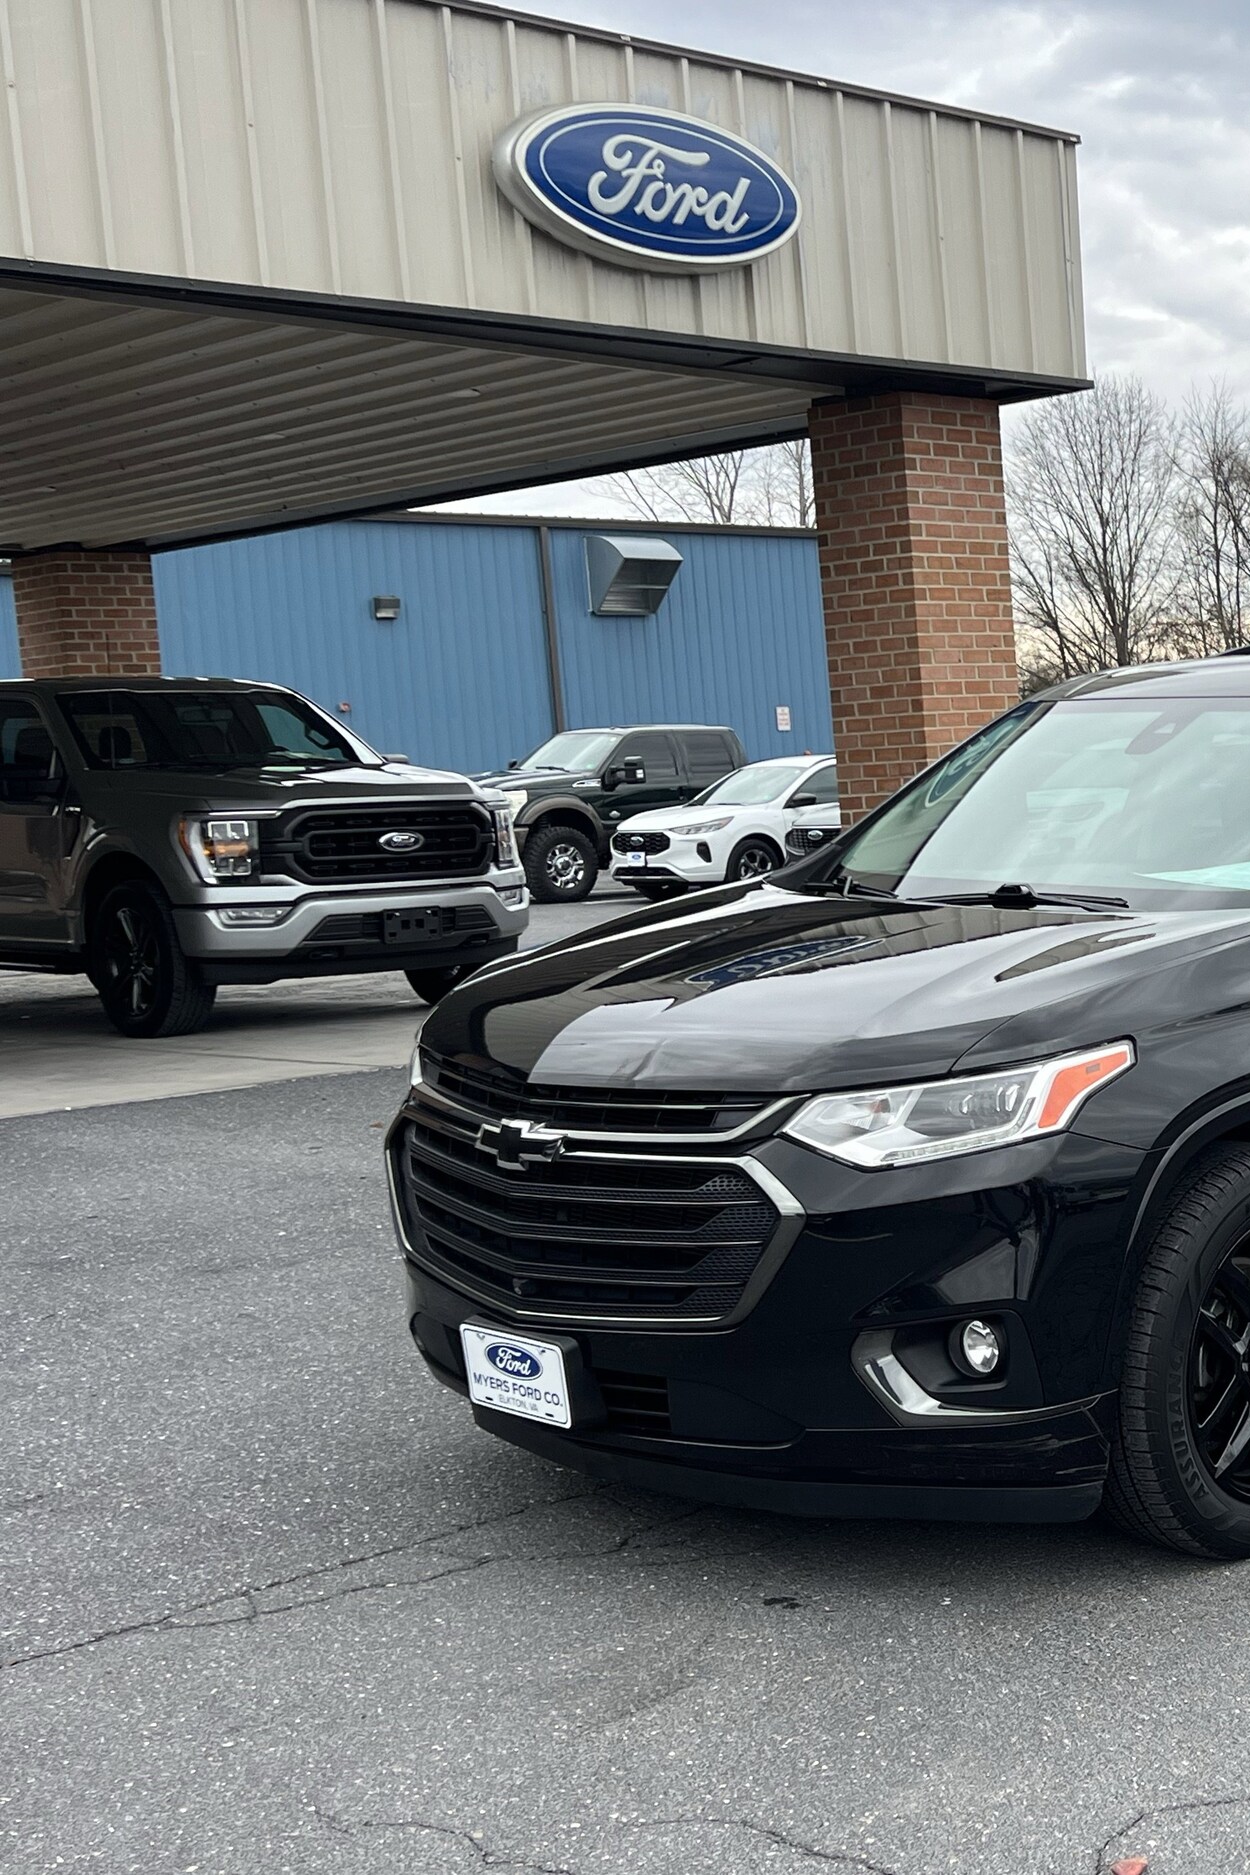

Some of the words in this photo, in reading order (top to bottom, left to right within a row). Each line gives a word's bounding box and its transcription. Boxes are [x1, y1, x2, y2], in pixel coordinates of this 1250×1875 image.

[587, 134, 751, 234] Ford
[496, 1346, 532, 1376] Ford
[473, 1372, 510, 1393] MYERS
[512, 1382, 542, 1401] FORD
[544, 1391, 564, 1407] CO.
